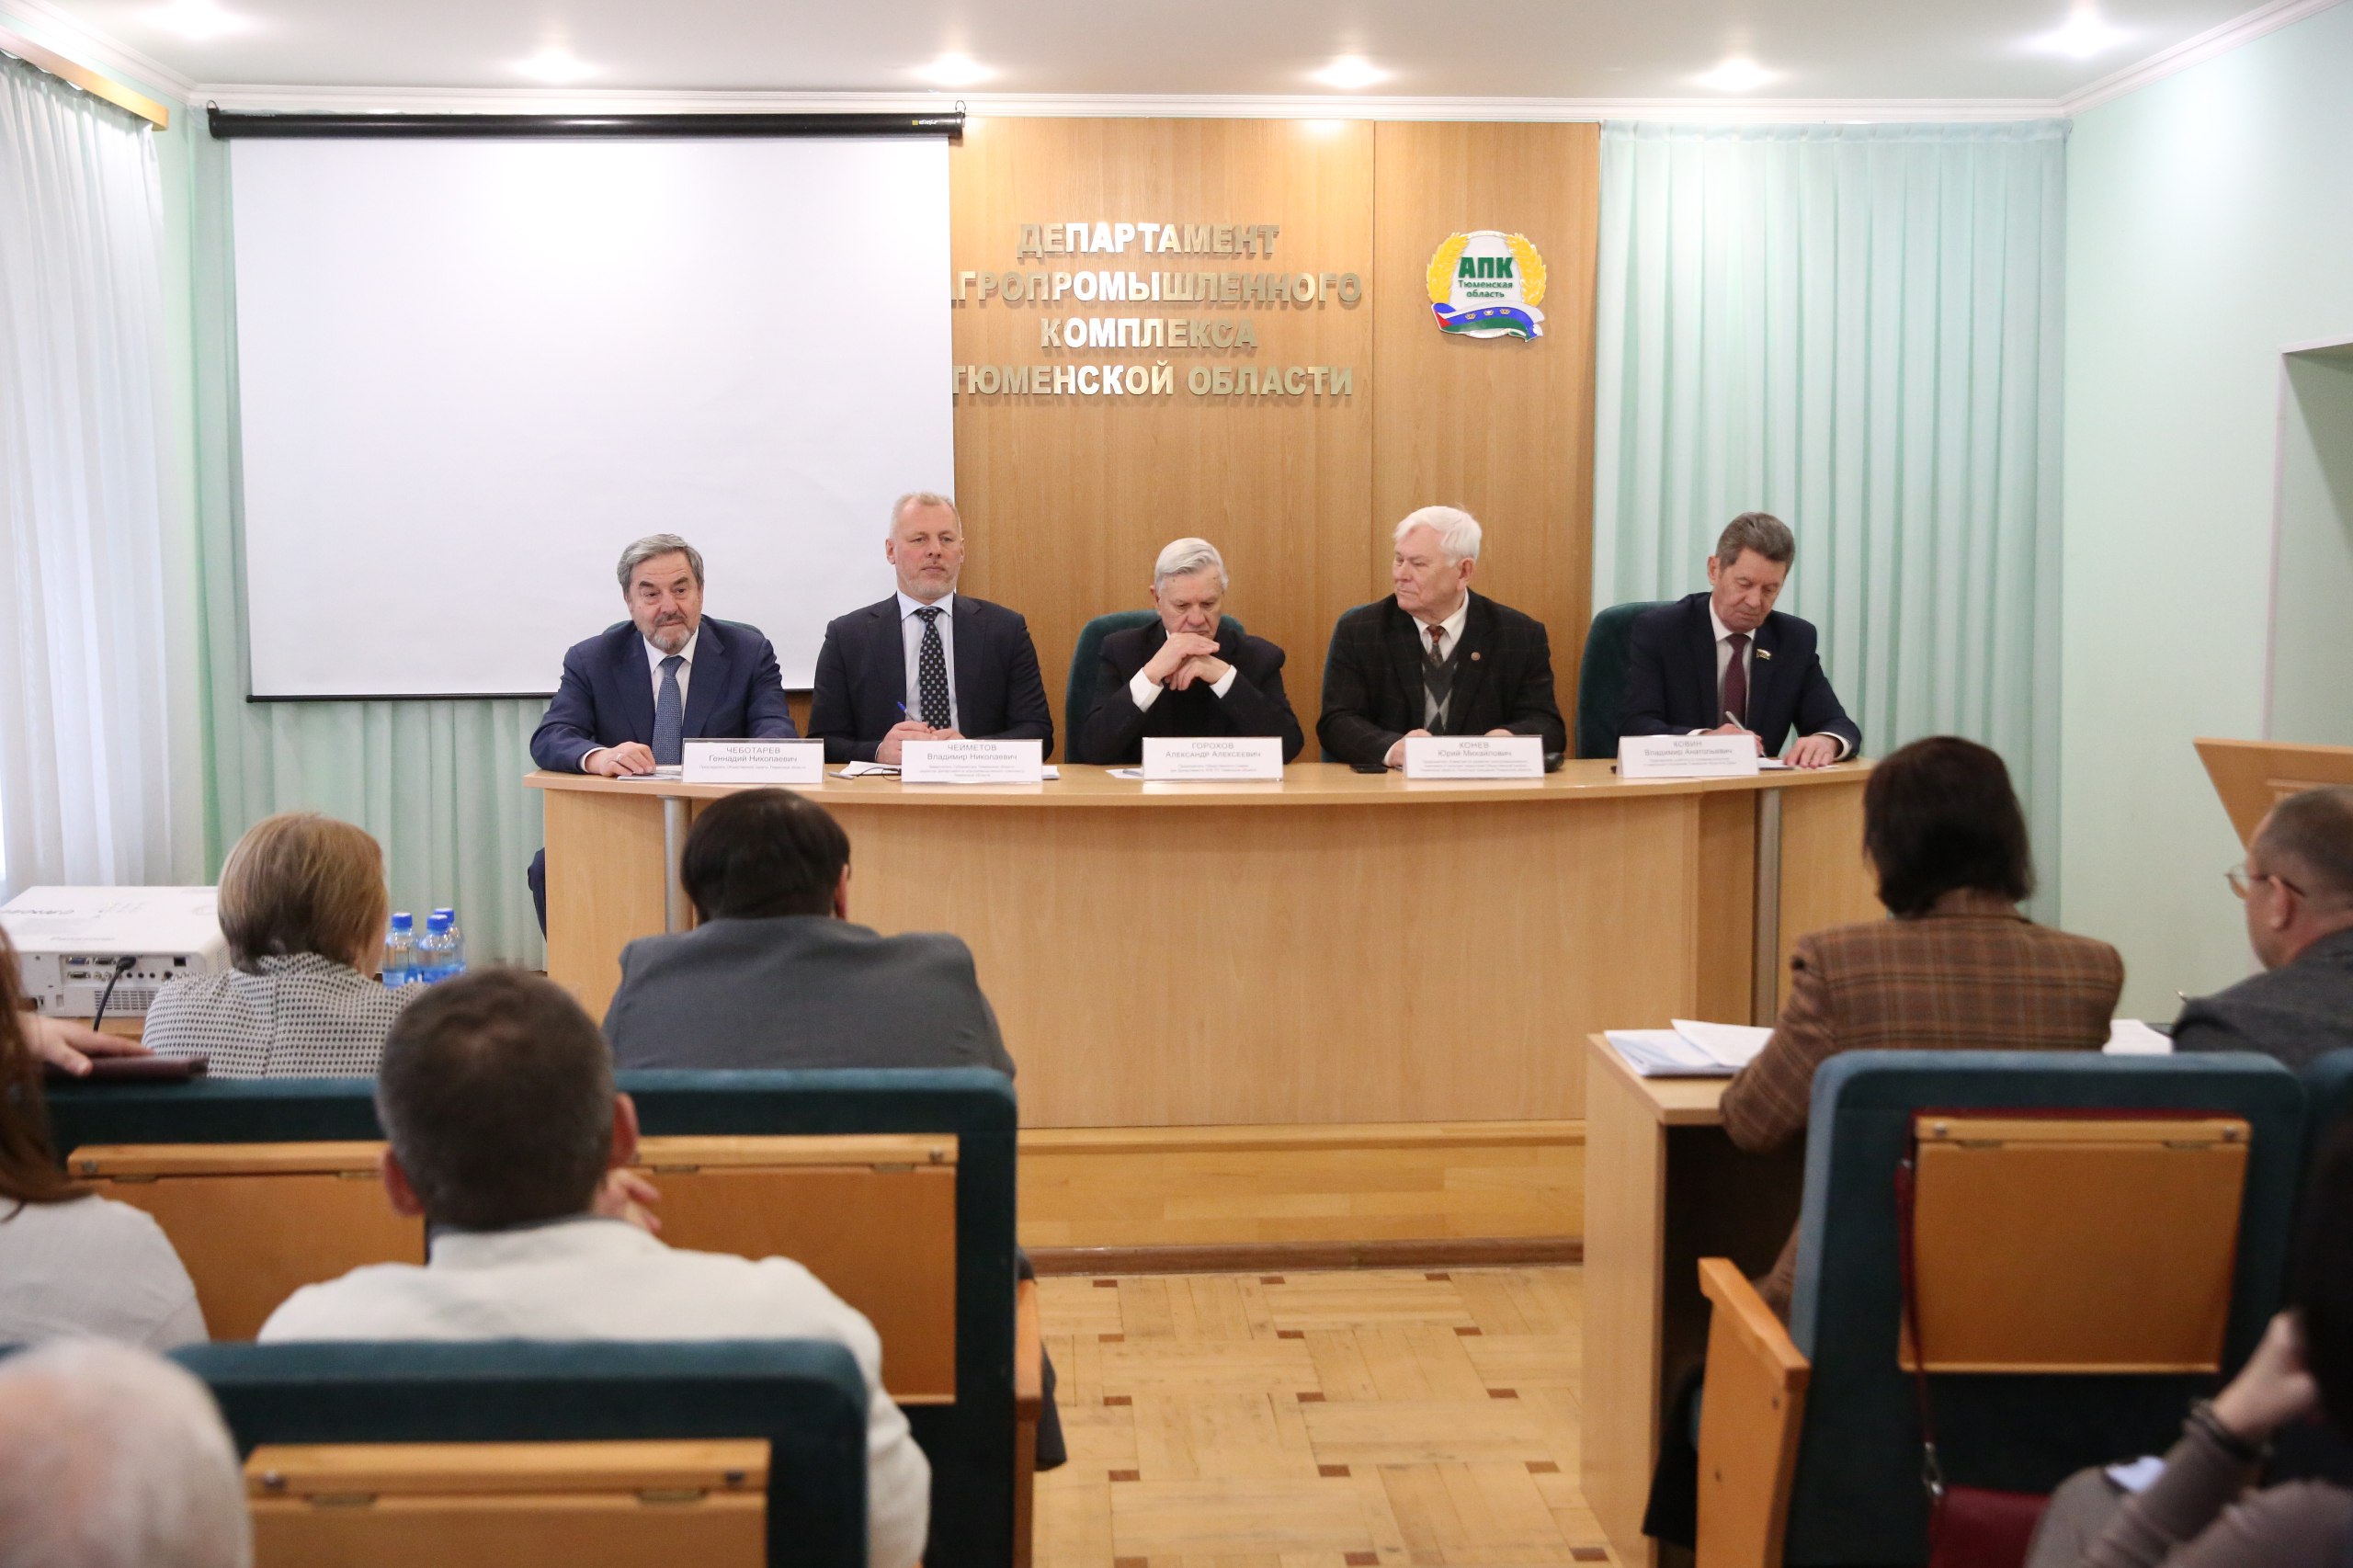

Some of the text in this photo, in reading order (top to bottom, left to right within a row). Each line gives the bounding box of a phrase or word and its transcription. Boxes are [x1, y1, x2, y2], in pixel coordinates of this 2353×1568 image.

[1017, 223, 1280, 258] ДЕПАРТАМЕНТ
[1459, 256, 1513, 278] АПК
[951, 271, 1362, 302] ГРОПРОМЫШЛЕННОГО
[1458, 279, 1513, 290] Тюменская
[1466, 289, 1505, 299] область
[1041, 317, 1258, 348] КОМПЛЕКСА
[1188, 365, 1352, 395] ОБЛАСТИ
[709, 755, 798, 763] Геннадий Николаевич
[926, 753, 1017, 761] Владимир Николаевич
